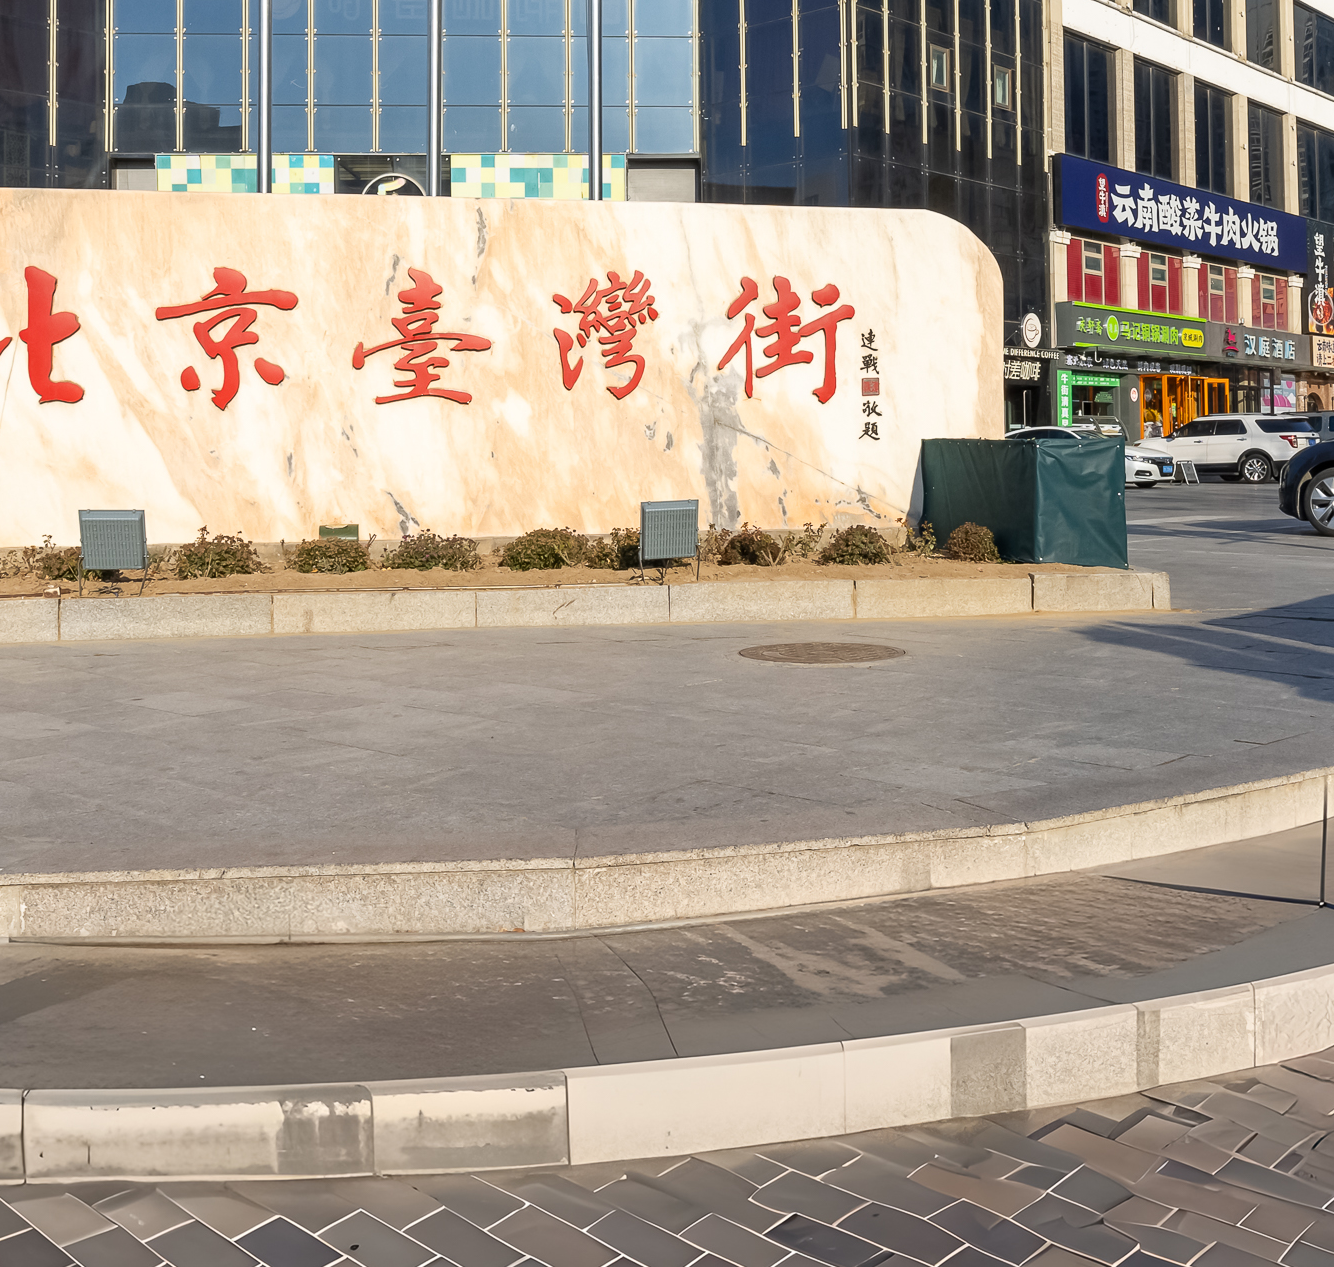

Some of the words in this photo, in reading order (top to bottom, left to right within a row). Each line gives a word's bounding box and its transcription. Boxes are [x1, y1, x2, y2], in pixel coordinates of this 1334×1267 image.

[1110, 182, 1280, 257] 云南酸菜牛肉火锅
[1040, 350, 1060, 360] COFFEE
[1244, 333, 1296, 361] 汉庭酒店
